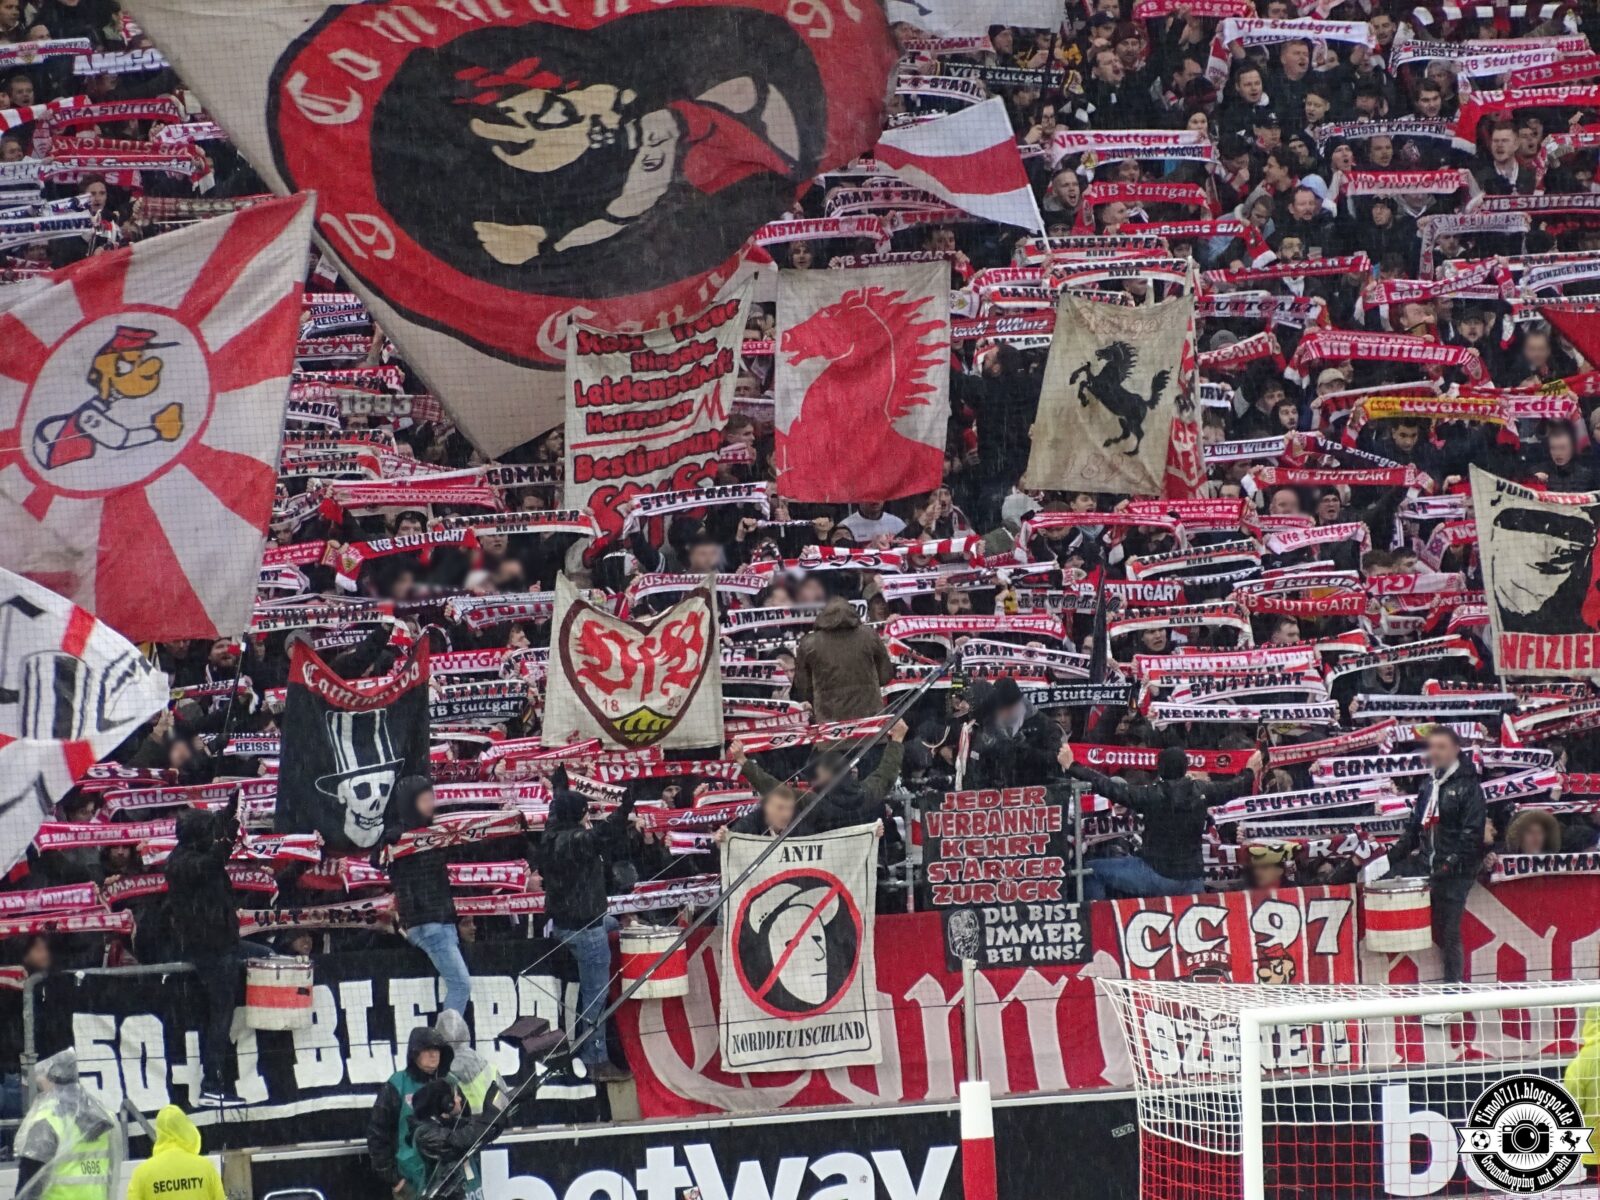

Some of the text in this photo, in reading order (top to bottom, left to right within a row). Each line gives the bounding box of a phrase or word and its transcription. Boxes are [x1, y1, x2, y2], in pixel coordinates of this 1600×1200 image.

[755, 218, 839, 239] ANNSTATTER
[1431, 270, 1494, 296] CANNST
[488, 465, 564, 485] COMM
[430, 651, 502, 671] TUTTGA
[963, 644, 1090, 669] ECKAR STADI
[601, 700, 620, 713] 18
[941, 786, 1047, 811] JEDER
[925, 805, 1062, 838] VERBANNTE
[780, 844, 824, 864] ANTI
[940, 834, 1050, 859] KEHRT
[1503, 853, 1600, 877] COMMAN
[932, 879, 1063, 905] ZURÜCK
[984, 903, 1080, 924] DU BIST
[985, 923, 1083, 946] IMMER
[1125, 898, 1353, 969] CC 97
[986, 942, 1084, 964] BEI UNS!
[1186, 952, 1229, 967] SZENE
[731, 1021, 866, 1055] NORDDEUTSCHLAND
[153, 1177, 204, 1194] SECURITY
